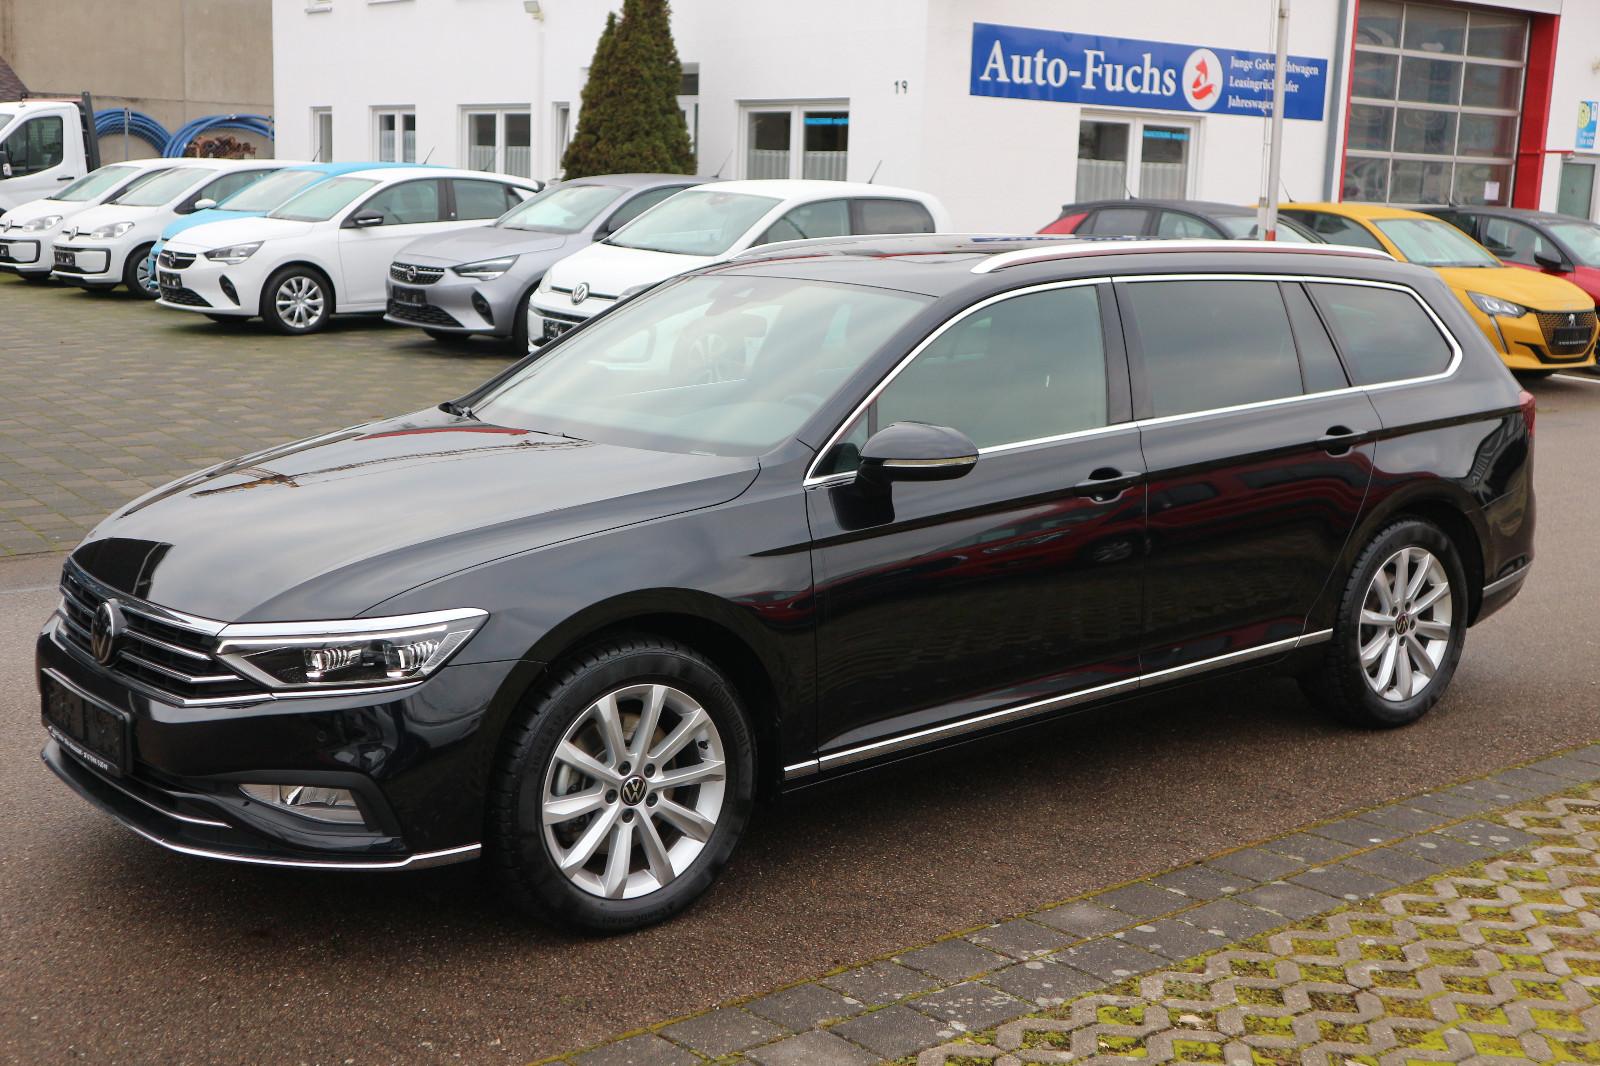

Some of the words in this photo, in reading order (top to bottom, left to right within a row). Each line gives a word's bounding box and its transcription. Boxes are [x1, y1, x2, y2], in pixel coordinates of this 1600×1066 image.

[979, 39, 1177, 97] Auto-Fuchs
[1231, 56, 1253, 72] Junge
[1255, 58, 1319, 78] Gebrchtwagen
[894, 80, 908, 95] 19
